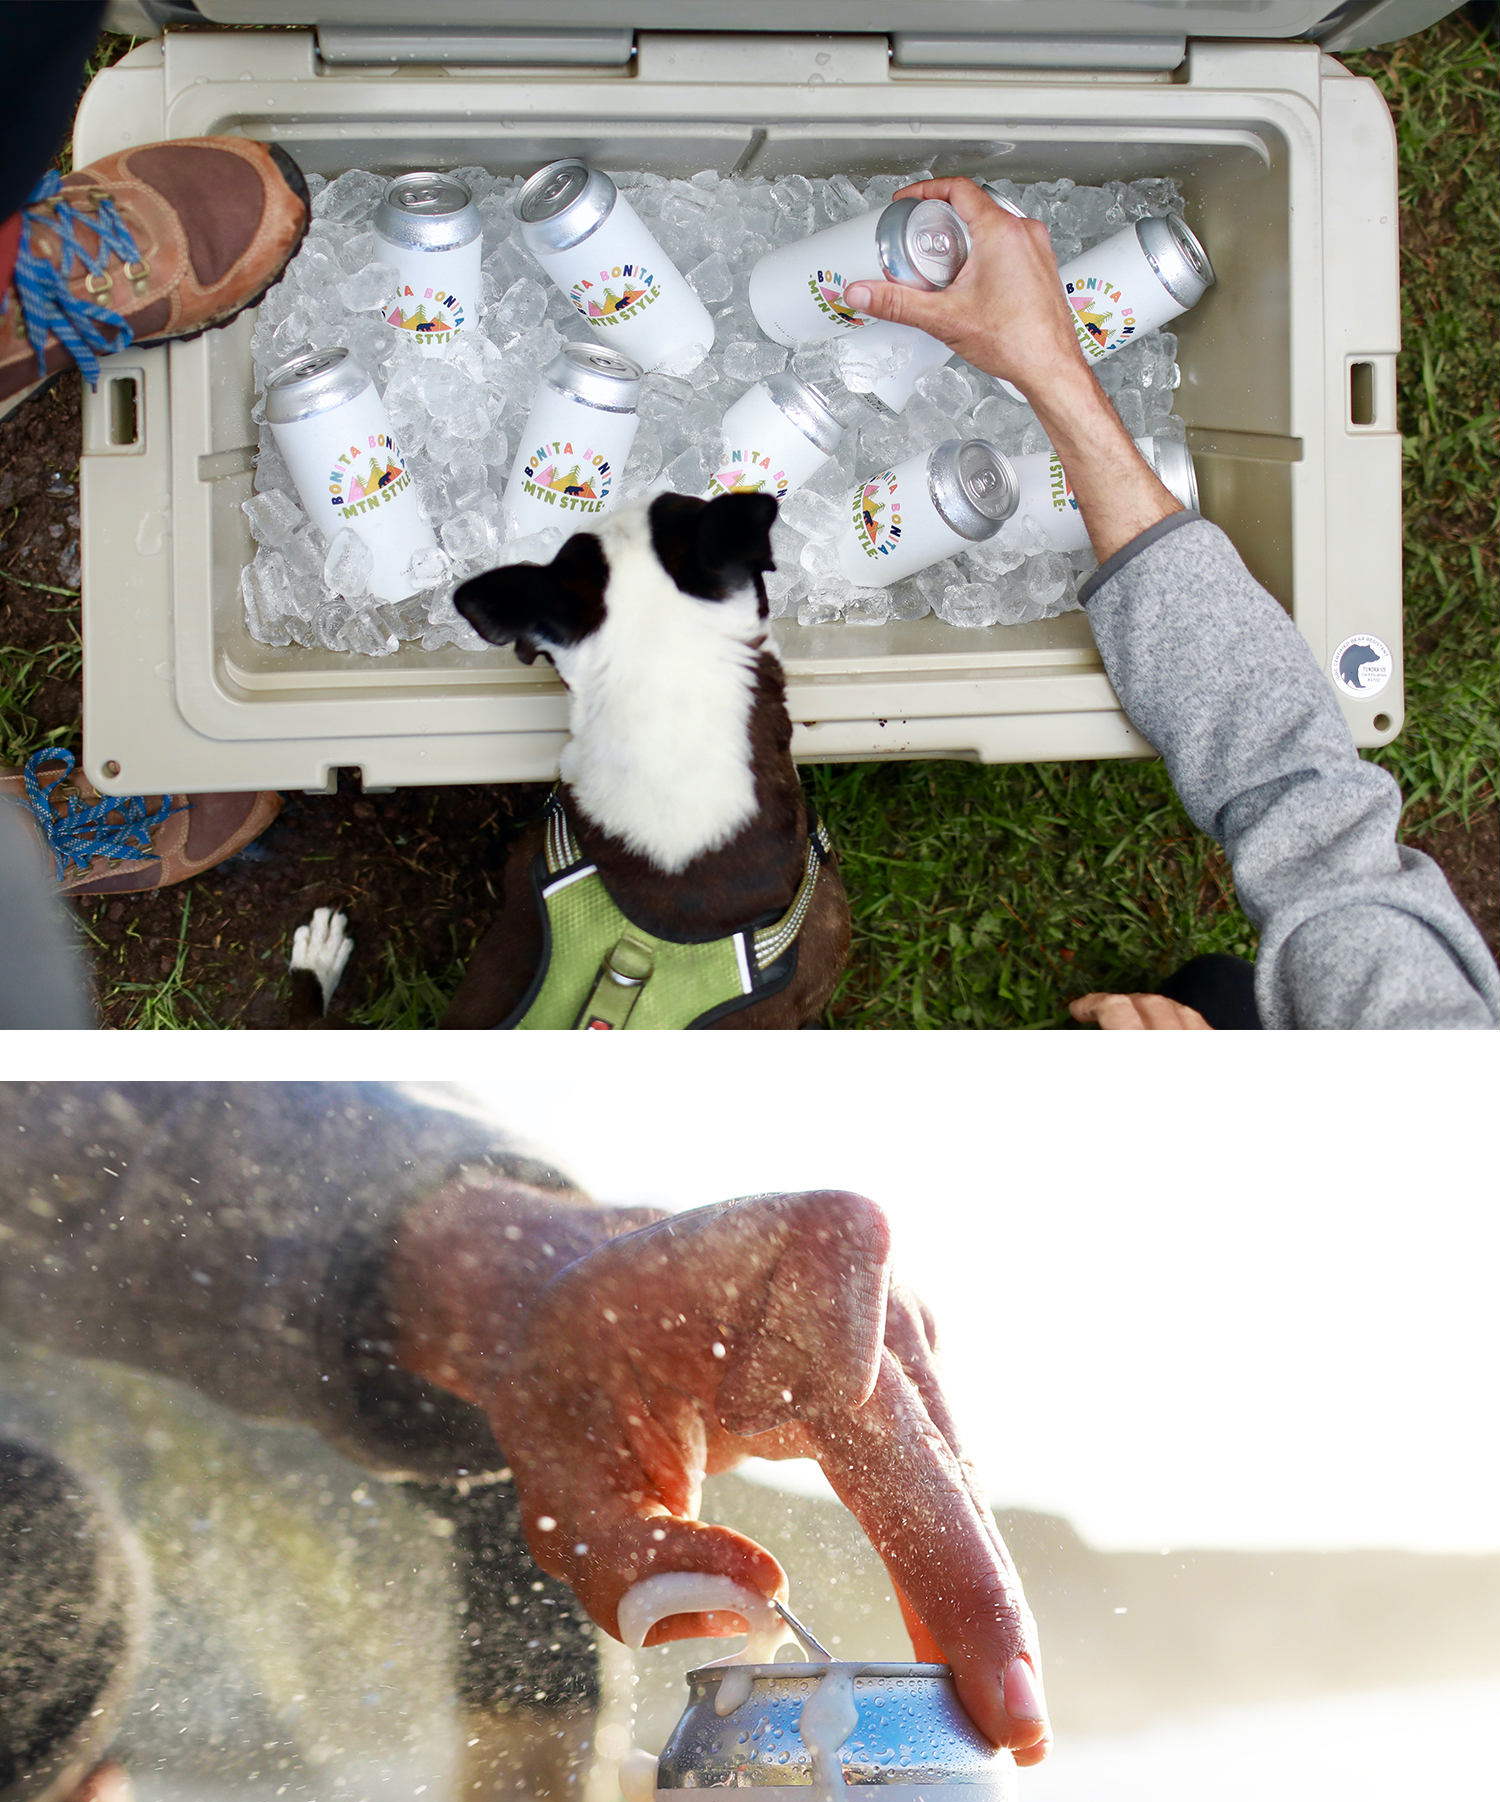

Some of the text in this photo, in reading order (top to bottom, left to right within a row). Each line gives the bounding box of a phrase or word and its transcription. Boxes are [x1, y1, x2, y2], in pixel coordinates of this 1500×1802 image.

[600, 264, 654, 288] BONITA
[807, 279, 831, 314] MTN
[816, 269, 848, 290] BONI
[424, 287, 466, 328] BONITA
[587, 284, 661, 327] MTN STYLE
[1065, 276, 1137, 350] BONITA BONITA
[328, 445, 362, 506] BONITA
[523, 441, 612, 500] BONITA BONITA
[718, 448, 789, 501] ONITA BON
[1048, 463, 1067, 508] STYLE
[340, 494, 381, 520] MTN
[523, 479, 604, 513] MTN STYLE
[852, 512, 879, 558] STYLE
[877, 502, 902, 556] BONITA
